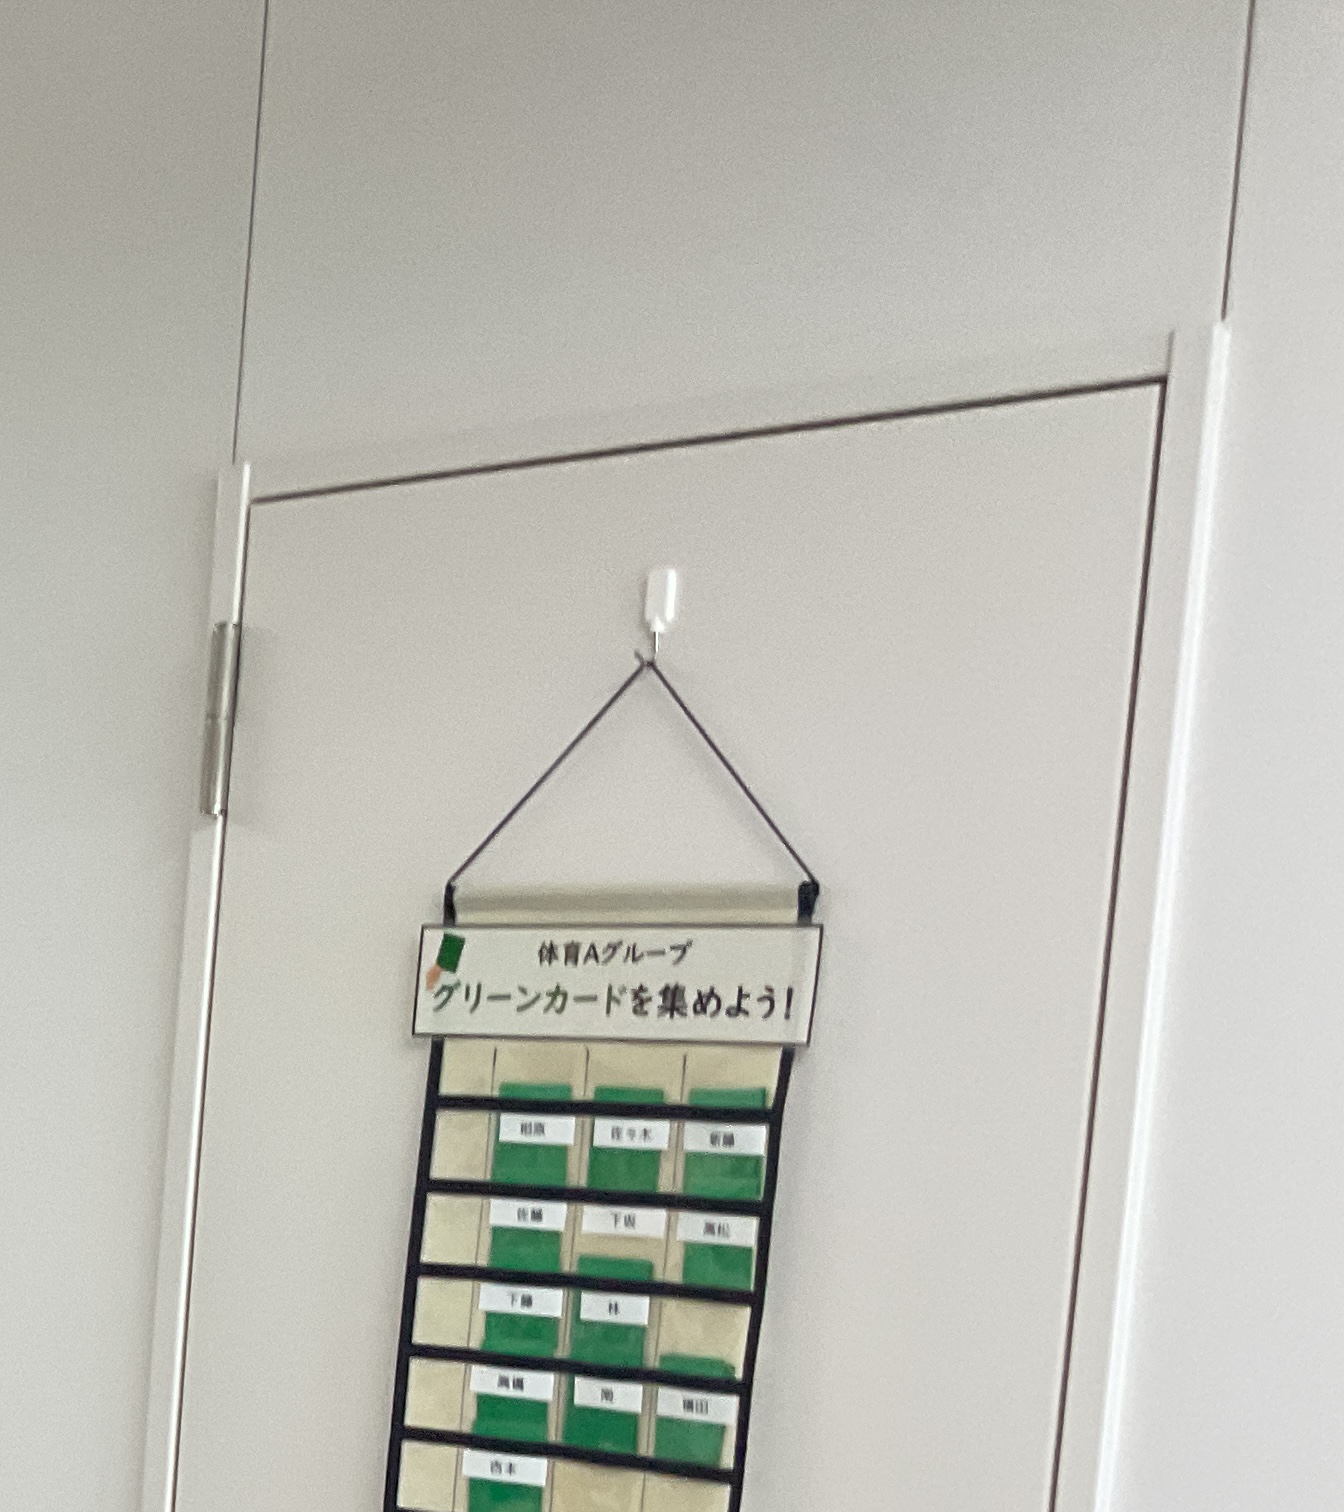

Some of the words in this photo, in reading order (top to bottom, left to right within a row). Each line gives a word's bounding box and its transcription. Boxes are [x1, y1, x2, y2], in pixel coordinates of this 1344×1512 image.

[538, 939, 693, 968] 体育Aグループ
